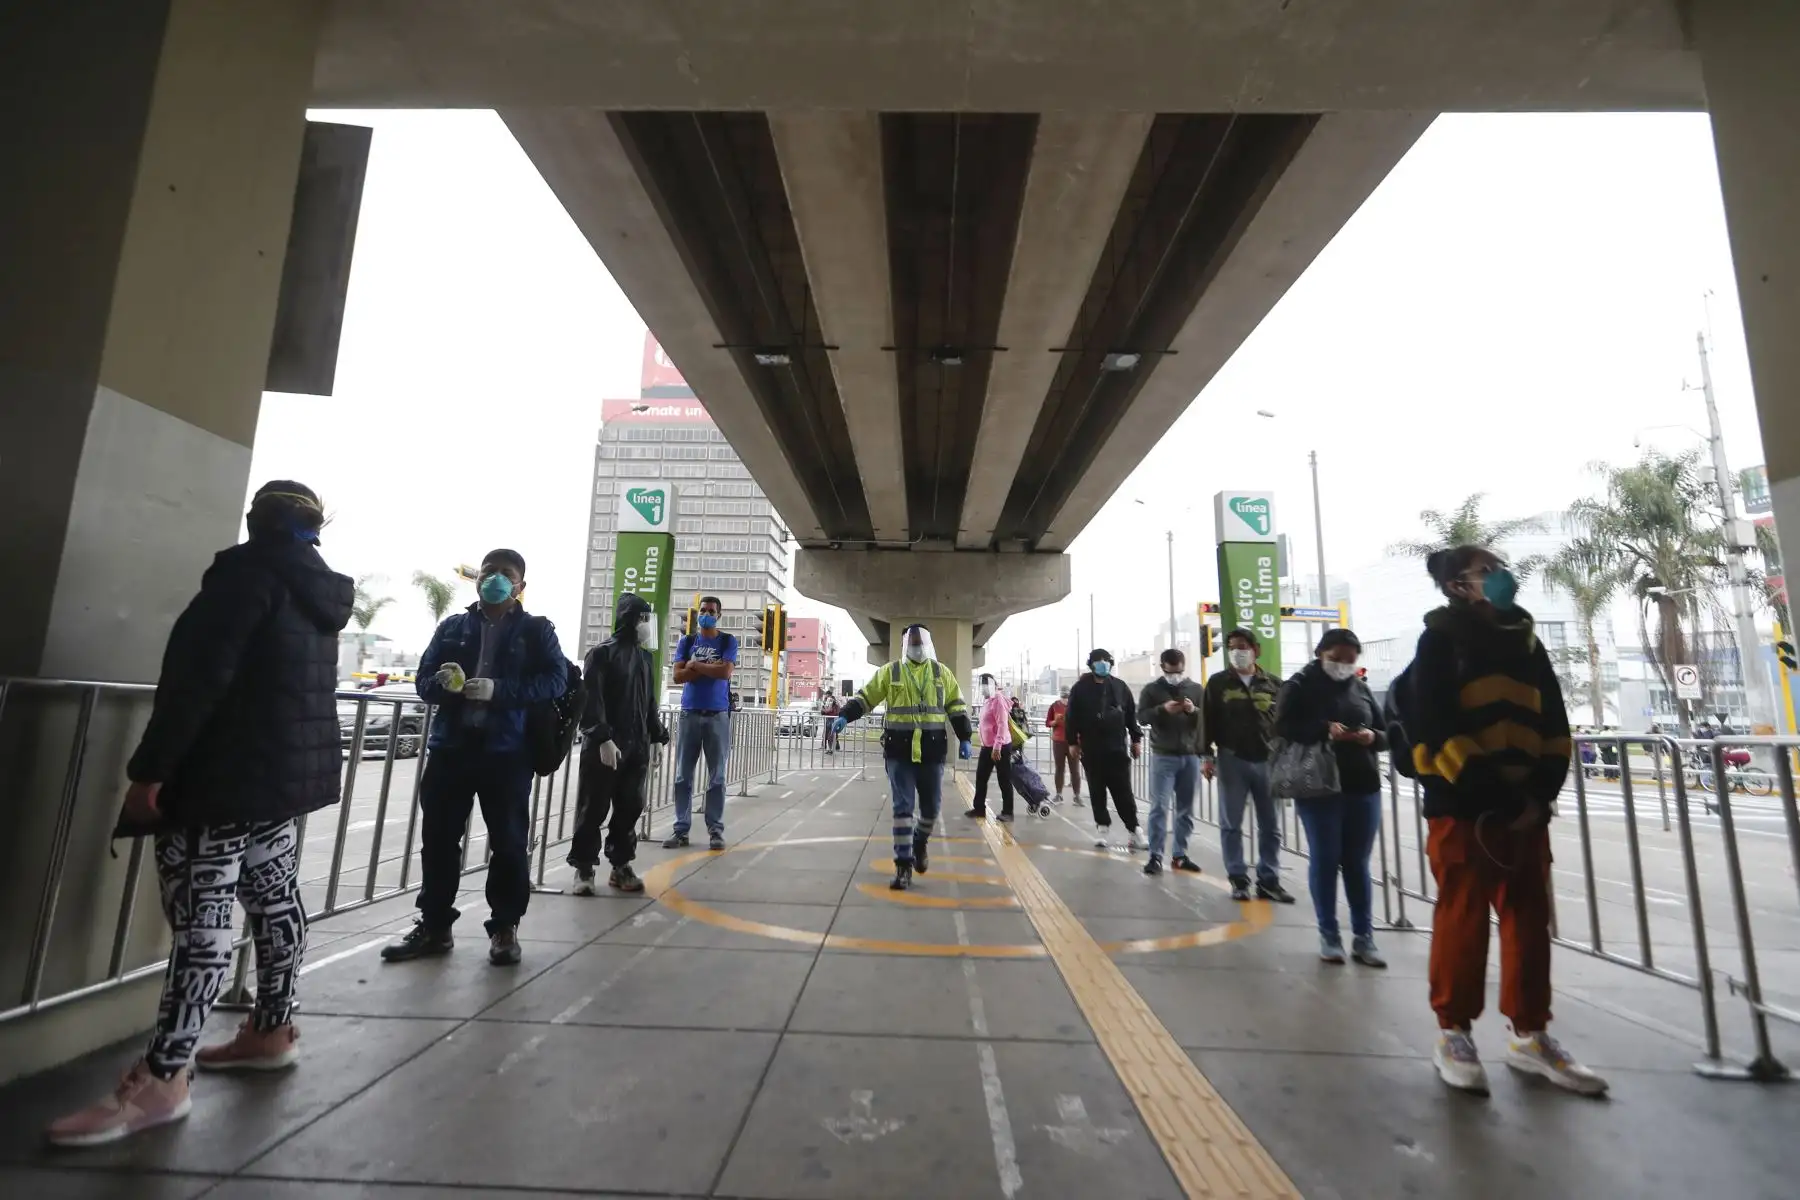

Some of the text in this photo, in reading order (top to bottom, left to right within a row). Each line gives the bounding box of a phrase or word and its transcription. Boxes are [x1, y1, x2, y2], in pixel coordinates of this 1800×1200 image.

[685, 406, 702, 417] un
[652, 505, 661, 522] 1
[1257, 514, 1268, 532] 1
[621, 567, 638, 594] tro
[639, 546, 659, 593] Lima
[1254, 556, 1276, 639] de Lima
